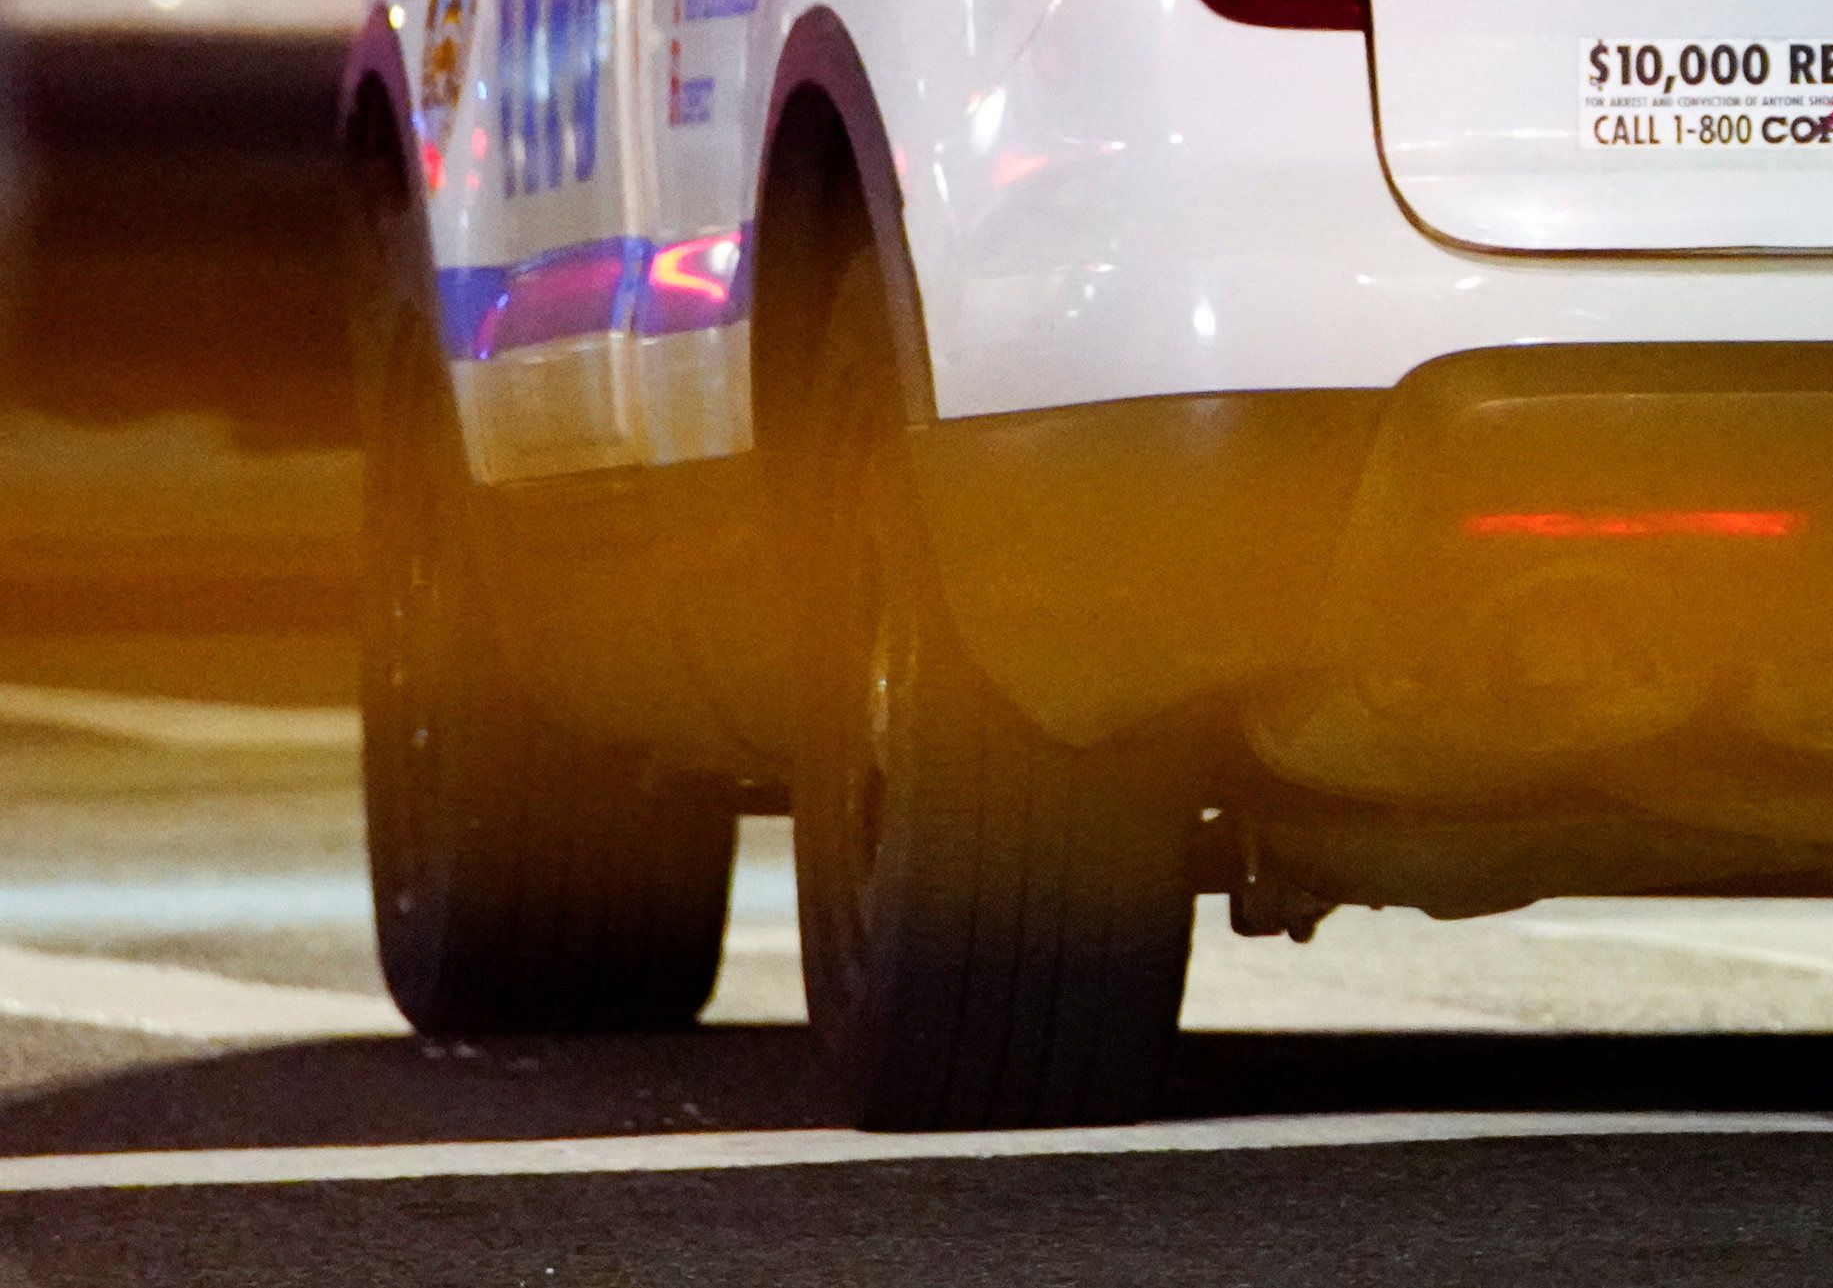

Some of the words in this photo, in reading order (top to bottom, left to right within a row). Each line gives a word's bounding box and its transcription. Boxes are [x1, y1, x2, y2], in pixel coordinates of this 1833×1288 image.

[1588, 38, 1771, 95] $10,000
[1762, 95, 1804, 107] ANYONE
[1593, 114, 1662, 145] CALL
[1673, 113, 1753, 145] 1-800
